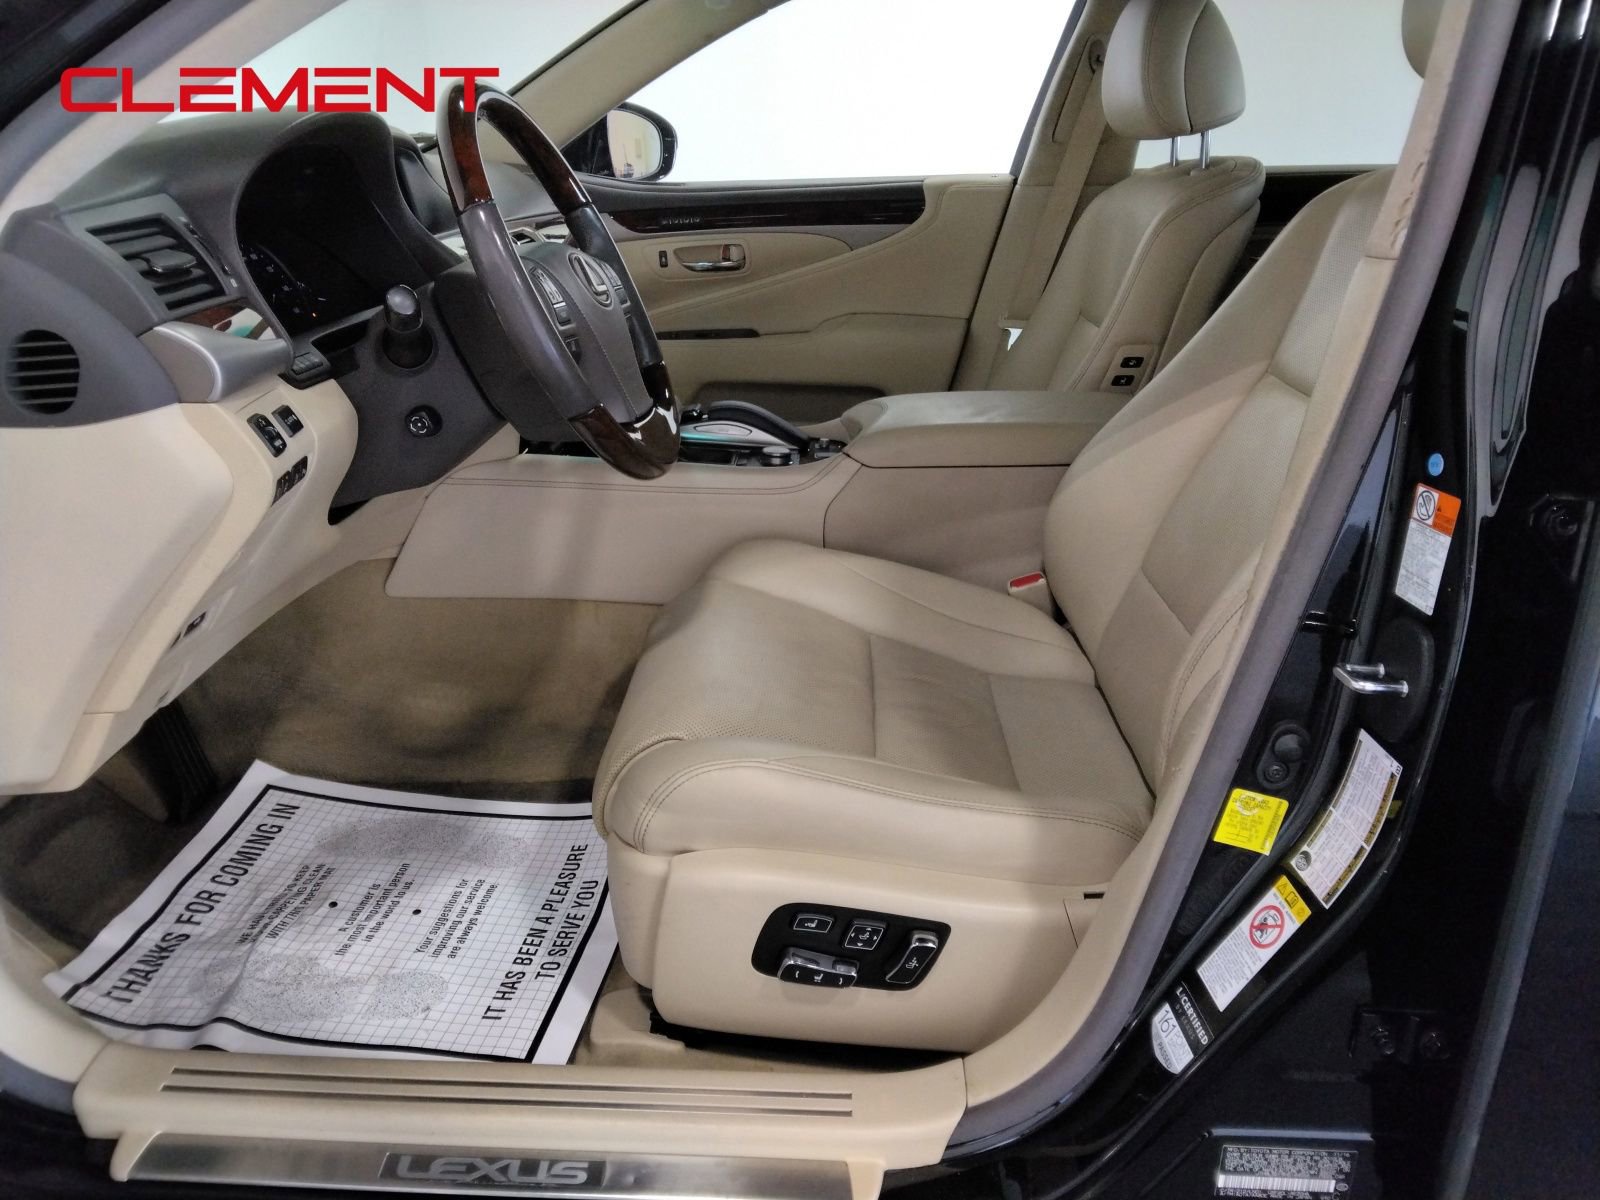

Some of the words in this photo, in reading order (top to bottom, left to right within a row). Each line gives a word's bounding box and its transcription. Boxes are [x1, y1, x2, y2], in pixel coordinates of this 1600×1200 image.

[268, 886, 307, 920] CARPETING
[302, 864, 326, 885] CLEAN
[541, 843, 588, 912] PLEASURE
[571, 879, 599, 909] YOU
[102, 932, 191, 1003] THANKS
[174, 890, 226, 926] FOR
[210, 823, 284, 887] COMING
[267, 803, 301, 820] IN
[235, 932, 252, 944] WE
[283, 883, 297, 892] TO
[293, 864, 309, 882] KEEP
[265, 920, 289, 939] WITH
[282, 905, 305, 921] THIS
[299, 881, 324, 905] PAPER
[334, 943, 351, 956] the
[347, 923, 368, 942] most
[360, 888, 393, 923] important
[388, 863, 411, 888] person
[345, 892, 375, 926] customer
[368, 883, 381, 891] is
[361, 934, 375, 942] in
[368, 921, 384, 933] the
[379, 900, 400, 920] world
[393, 891, 406, 899] to
[413, 936, 433, 953] Your
[429, 890, 462, 935] suggestions
[455, 879, 469, 889] for
[428, 920, 462, 958] improving
[456, 905, 469, 919] our
[464, 879, 486, 904] service
[535, 915, 555, 925] A
[447, 946, 461, 959] are
[456, 917, 478, 944] always
[512, 927, 548, 966] BEEN
[547, 912, 586, 957] SERVE
[493, 970, 526, 1001] HAS
[534, 961, 561, 980] TO
[482, 1005, 506, 1020] IT
[1158, 1009, 1177, 1038] 161
[1158, 1041, 1173, 1069] PASSED
[396, 1155, 589, 1185] LEXUS
